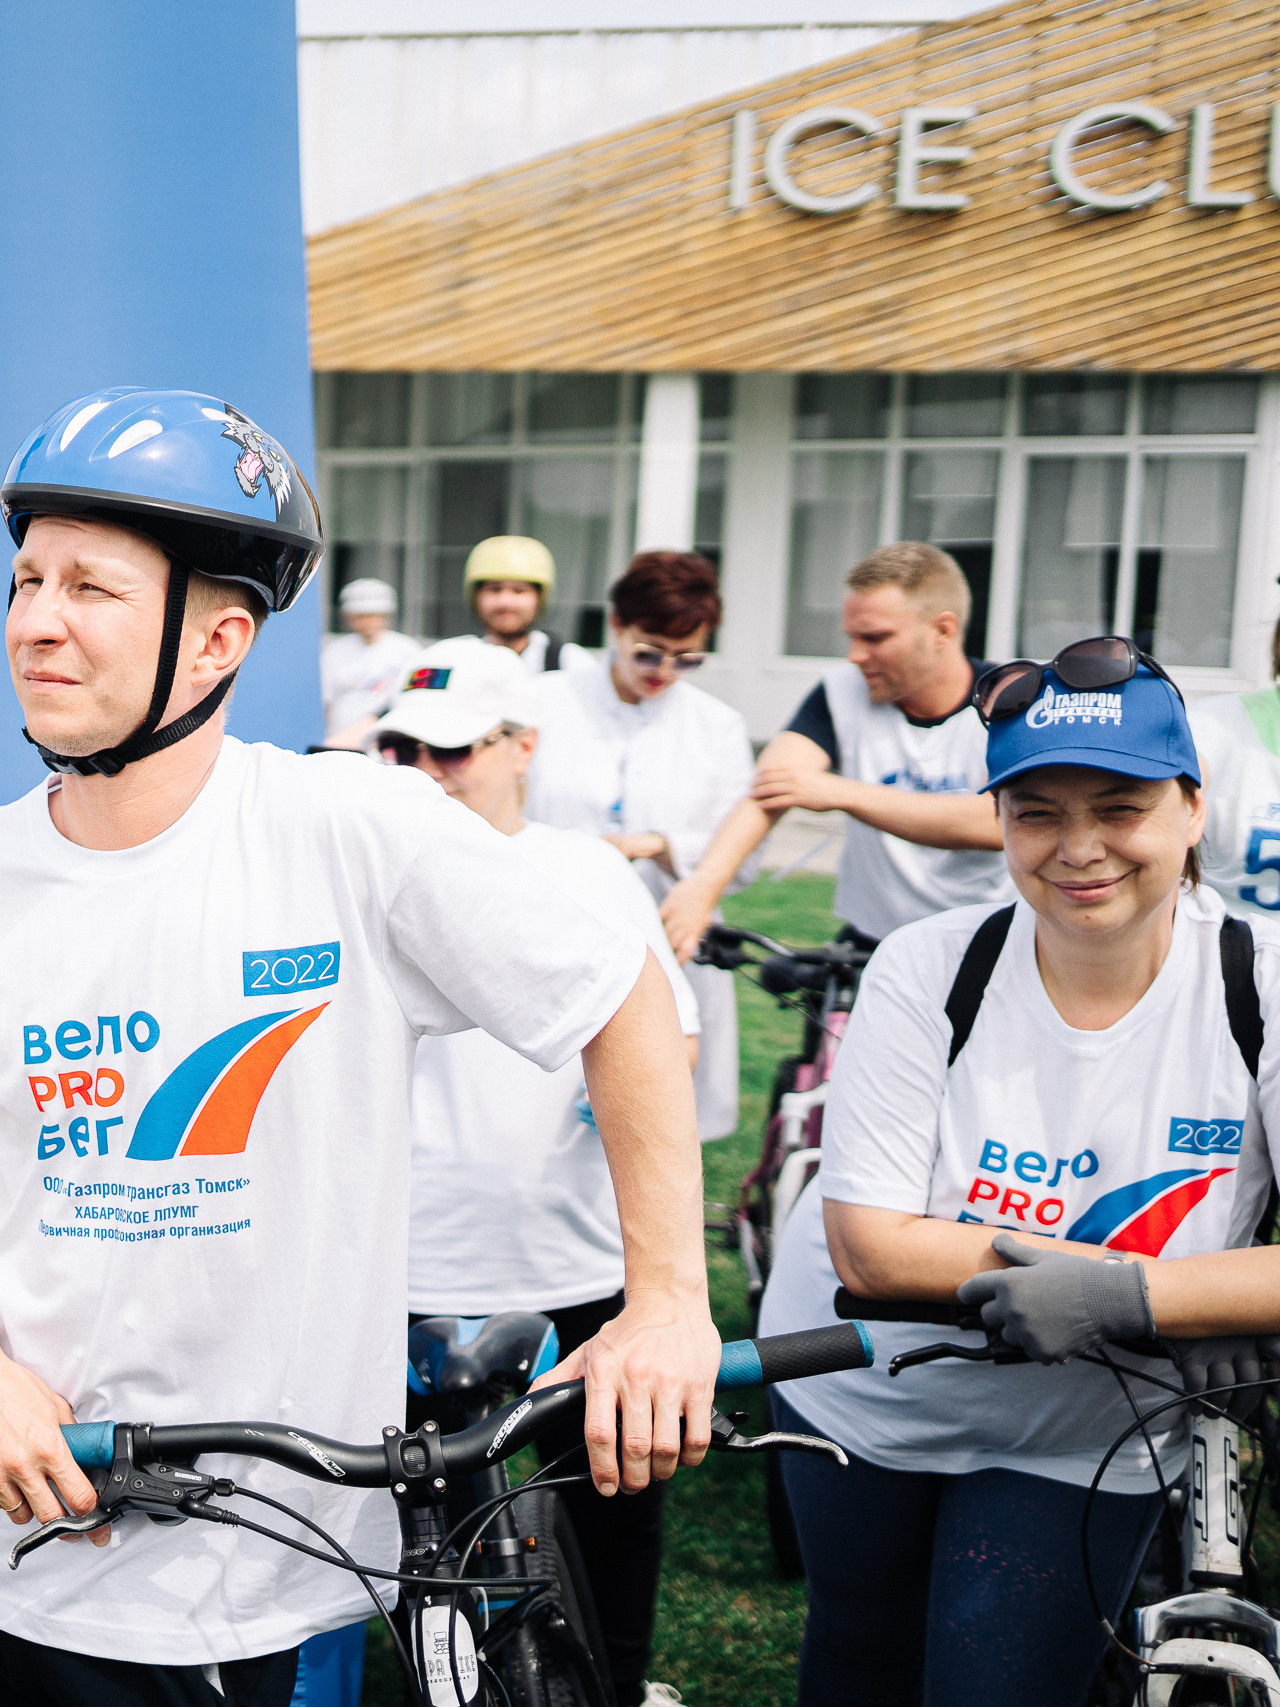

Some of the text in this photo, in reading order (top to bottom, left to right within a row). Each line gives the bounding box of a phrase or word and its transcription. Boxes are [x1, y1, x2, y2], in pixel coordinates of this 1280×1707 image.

[728, 102, 1280, 213] ICE CL
[1055, 692, 1122, 709] ГАЗПРОМ
[1053, 715, 1122, 727] ТОМСК
[250, 951, 335, 989] 2022
[28, 1068, 125, 1113] PRO
[1174, 1123, 1241, 1151] 2022
[127, 1182, 190, 1203] трансгаз
[195, 1177, 251, 1194] Томск»
[967, 1177, 1065, 1226] PRO
[153, 1205, 199, 1222] ЛПУМГ
[169, 1218, 251, 1240] организация
